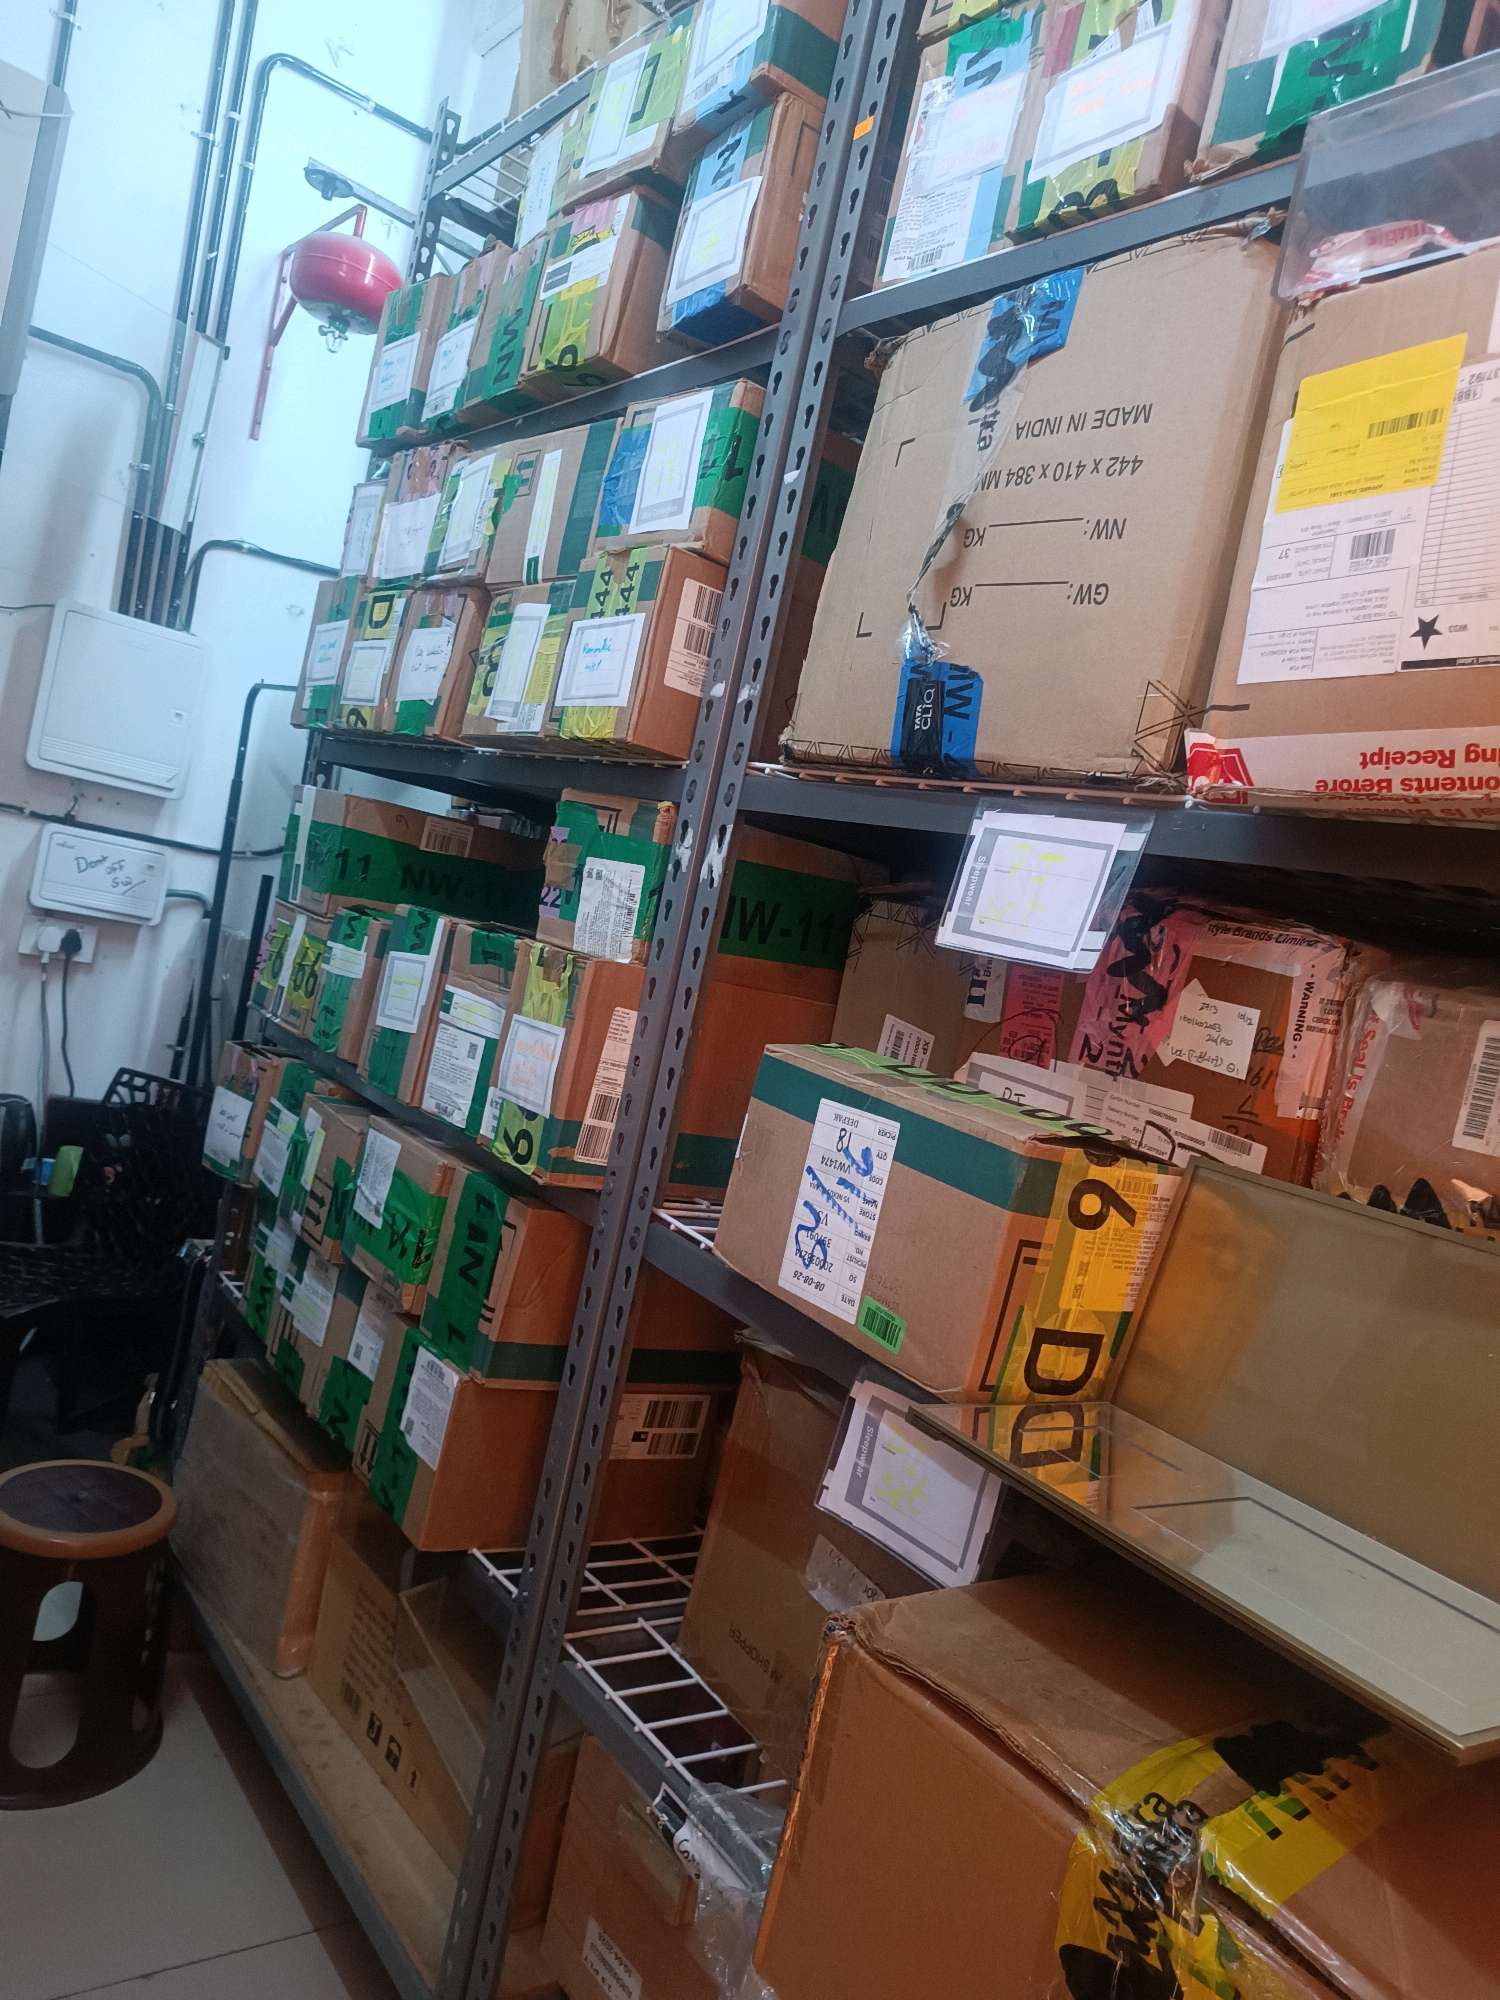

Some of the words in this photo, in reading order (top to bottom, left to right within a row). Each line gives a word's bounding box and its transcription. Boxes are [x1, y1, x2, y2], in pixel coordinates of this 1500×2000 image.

[1066, 412, 1087, 433] IN
[1091, 403, 1153, 431] MADE
[1015, 416, 1062, 441] INDIA
[1038, 465, 1050, 480] x
[1052, 458, 1085, 482] 410
[1090, 459, 1102, 474] x
[1105, 454, 1144, 477] 442
[1005, 466, 1034, 488] 384
[963, 526, 988, 549] KG
[1083, 517, 1127, 541] NW:
[1278, 548, 1290, 559] 37
[949, 585, 975, 608] KG
[1067, 583, 1110, 606] GW:
[914, 704, 922, 730] TATA
[1359, 747, 1456, 770] Receipt
[1314, 777, 1393, 793] Before
[963, 855, 988, 907] Sleepwear
[1232, 925, 1273, 942] Brands
[1291, 981, 1315, 1042] WARNING
[921, 1039, 931, 1056] XP
[1354, 1029, 1377, 1070] Seal
[833, 1112, 860, 1129] DEEPAK
[877, 1127, 897, 1142] PICKER
[820, 1154, 851, 1175] VW1474
[875, 1151, 888, 1161] QTY
[868, 1173, 884, 1186] CODE
[859, 1208, 876, 1222] STORE
[846, 1254, 867, 1269] PICKLIST
[792, 1269, 826, 1292] 08-08-26
[841, 1293, 856, 1307] DATE
[855, 1424, 874, 1479] Sleepwear
